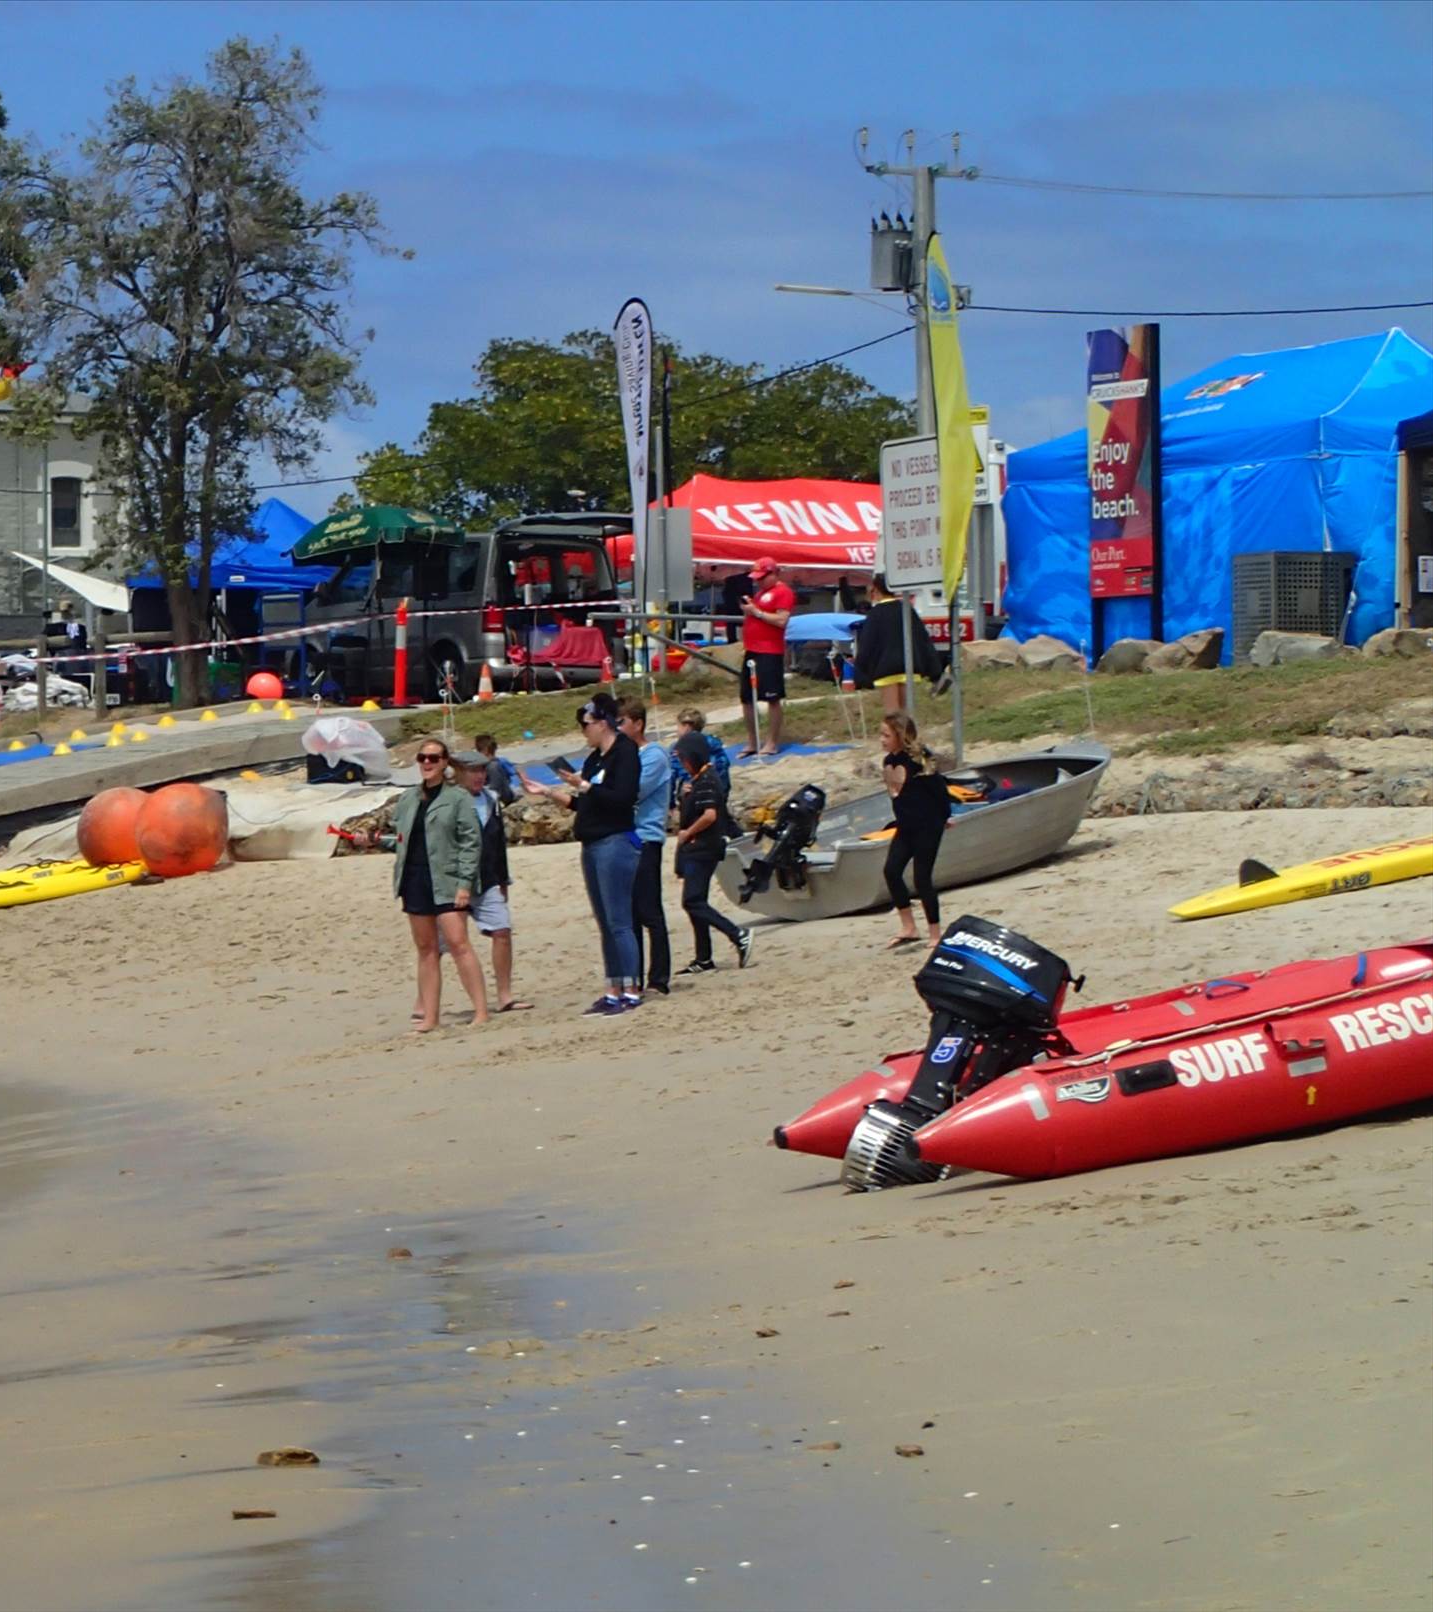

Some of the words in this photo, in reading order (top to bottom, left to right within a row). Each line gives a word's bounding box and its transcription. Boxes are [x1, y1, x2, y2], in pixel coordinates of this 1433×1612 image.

[1092, 438, 1130, 466] Enjoy
[890, 459, 902, 478] NO
[1091, 468, 1115, 491] the
[889, 487, 923, 508] PROCEED
[1091, 493, 1140, 519] beach.
[891, 520, 907, 540] THIS
[910, 517, 932, 537] POINT
[896, 550, 923, 570] SIGNAL
[948, 931, 1039, 970] MERCURY
[931, 1036, 963, 1063] 5
[1167, 1032, 1270, 1088] SURF
[1328, 993, 1433, 1053] RESC
